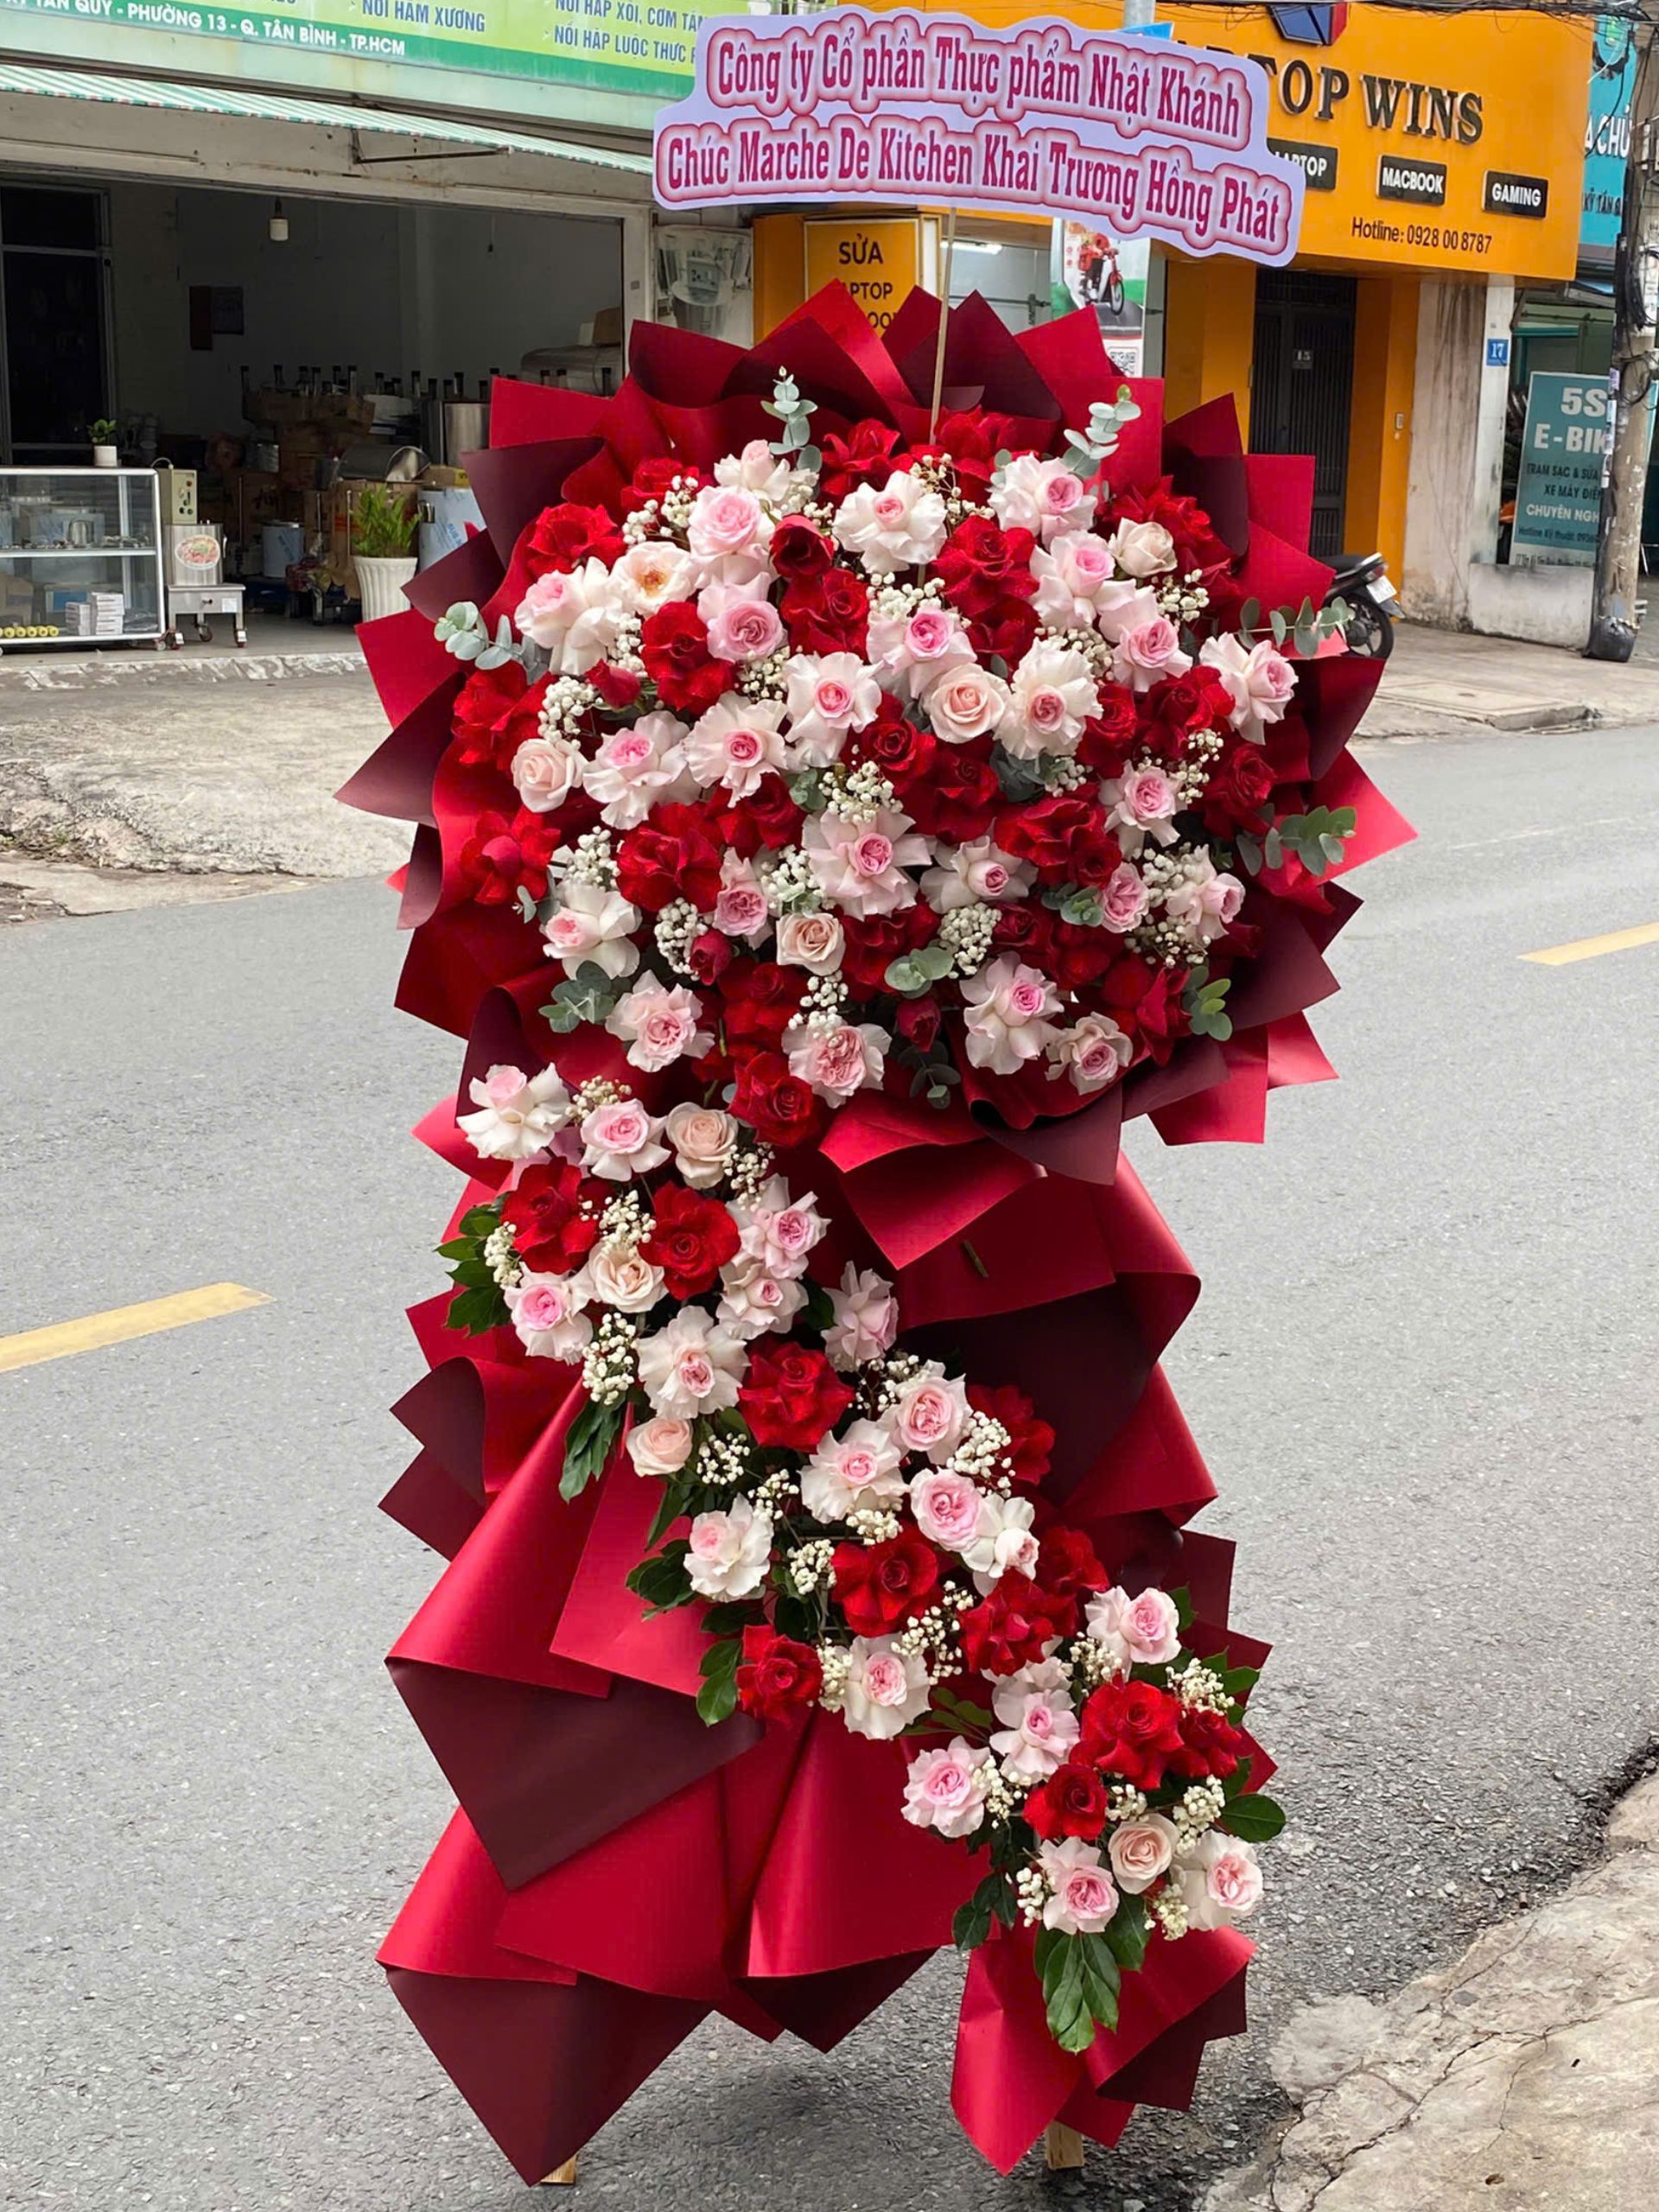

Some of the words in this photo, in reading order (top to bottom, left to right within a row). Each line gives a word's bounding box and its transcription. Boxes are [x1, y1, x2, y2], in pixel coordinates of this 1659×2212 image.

[127, 3, 202, 29] PHƯỜNG
[207, 14, 226, 31] 13
[240, 19, 258, 35] Q.
[263, 18, 295, 40] TÂN
[299, 24, 336, 46] BÌNH
[348, 34, 405, 55] TP.HCM
[435, 6, 486, 32] XƯƠNG
[647, 8, 677, 29] CƠM
[719, 41, 781, 104] Công
[791, 41, 814, 102] ty
[823, 27, 855, 88] Cổ
[861, 29, 925, 100] phần
[936, 37, 1000, 105] Thực
[1007, 39, 1079, 109] phẩm
[1089, 53, 1150, 125] Nhật
[1157, 67, 1239, 138] Khánh
[1359, 74, 1484, 144] WINS
[668, 135, 729, 190] Chúc
[738, 128, 830, 183] Marche
[838, 127, 869, 180] De
[878, 128, 973, 185] Kitchen
[982, 134, 1039, 192] Khai
[1145, 158, 1213, 238] Hồng
[1219, 176, 1279, 242] Phát
[1382, 167, 1444, 194] MACBOOK
[1491, 182, 1541, 207] GAMING
[838, 232, 884, 264] SỬA
[1351, 217, 1404, 243] Hotline:
[1407, 225, 1439, 248] 0928
[1443, 229, 1459, 250] 00
[1461, 232, 1492, 254] 8787
[843, 282, 893, 300] PTOP
[1491, 342, 1504, 359] 17
[1560, 387, 1608, 417] 5S
[1526, 504, 1571, 520] CHUYÊN
